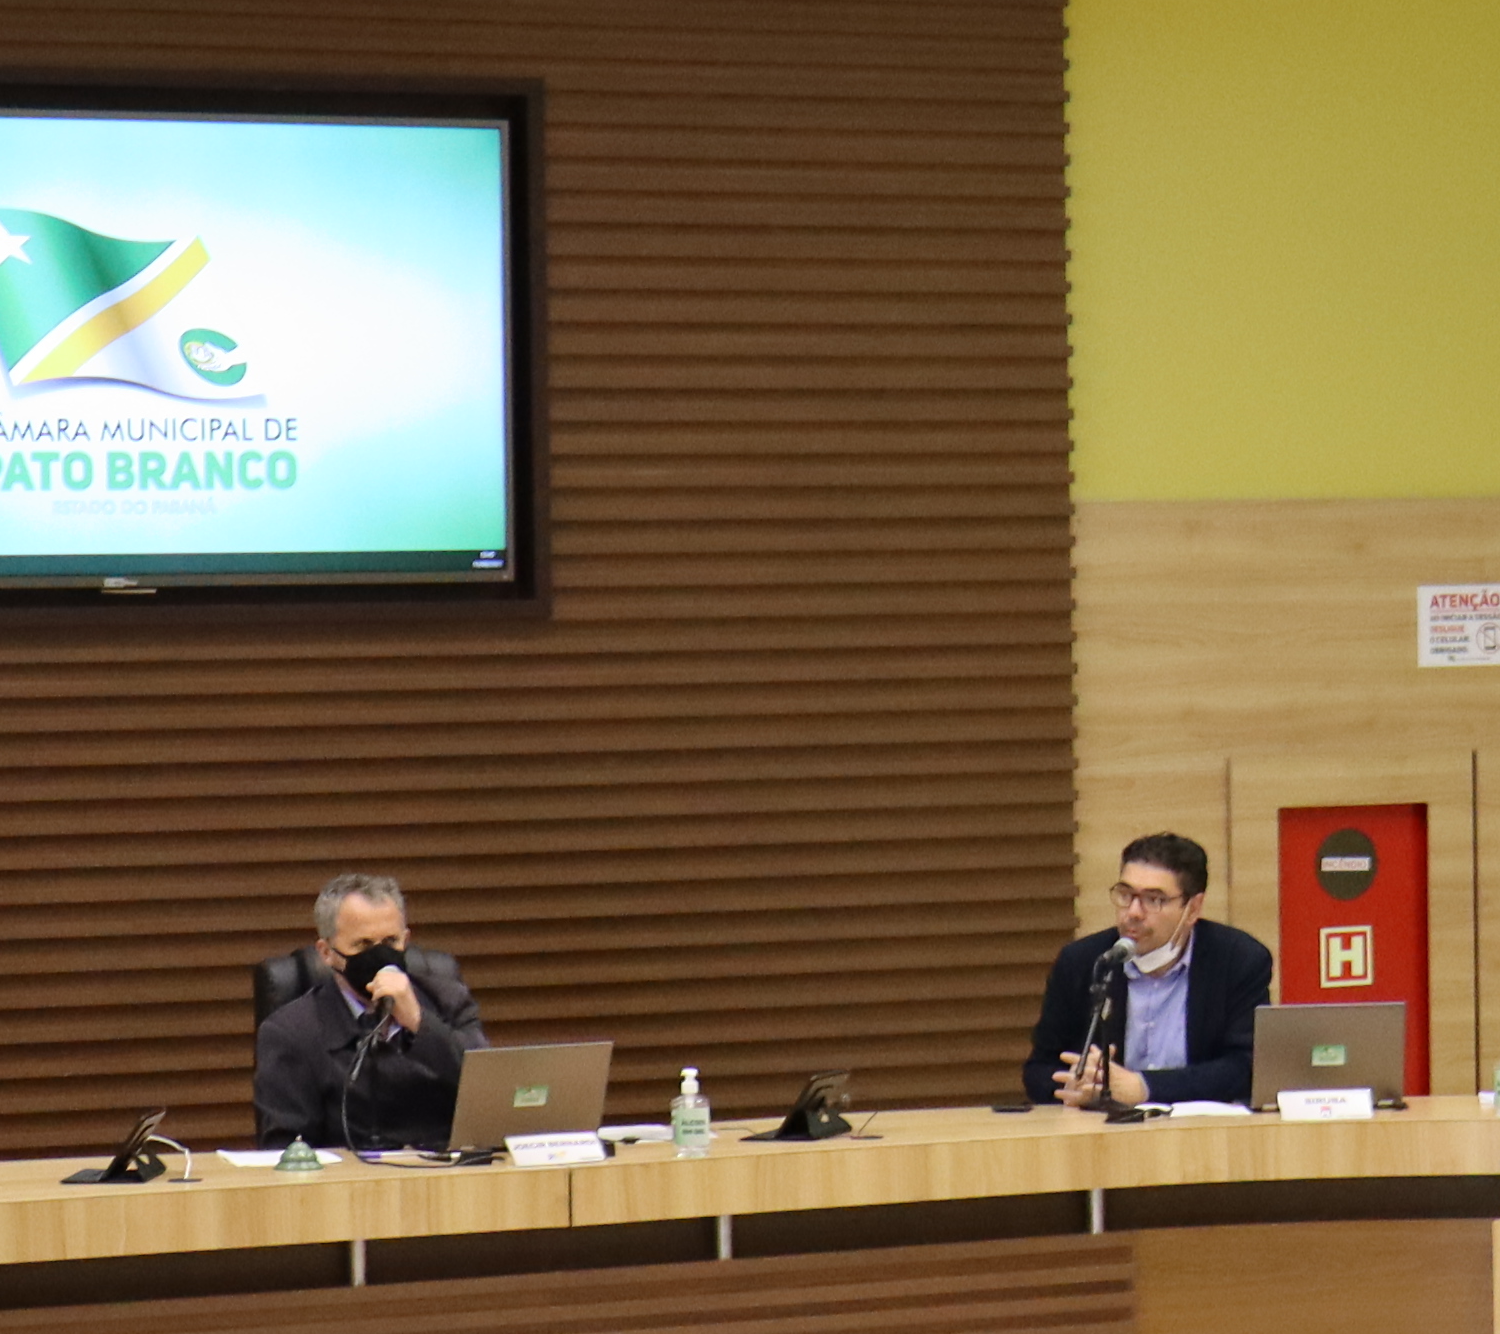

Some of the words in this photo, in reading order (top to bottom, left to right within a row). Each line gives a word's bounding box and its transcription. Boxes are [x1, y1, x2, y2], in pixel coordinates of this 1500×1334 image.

[100, 418, 253, 442] MUNICIPAL
[264, 418, 297, 441] DE
[106, 449, 298, 492] BRANCO
[1430, 589, 1500, 611] ATENÇÃO
[1328, 934, 1366, 978] H
